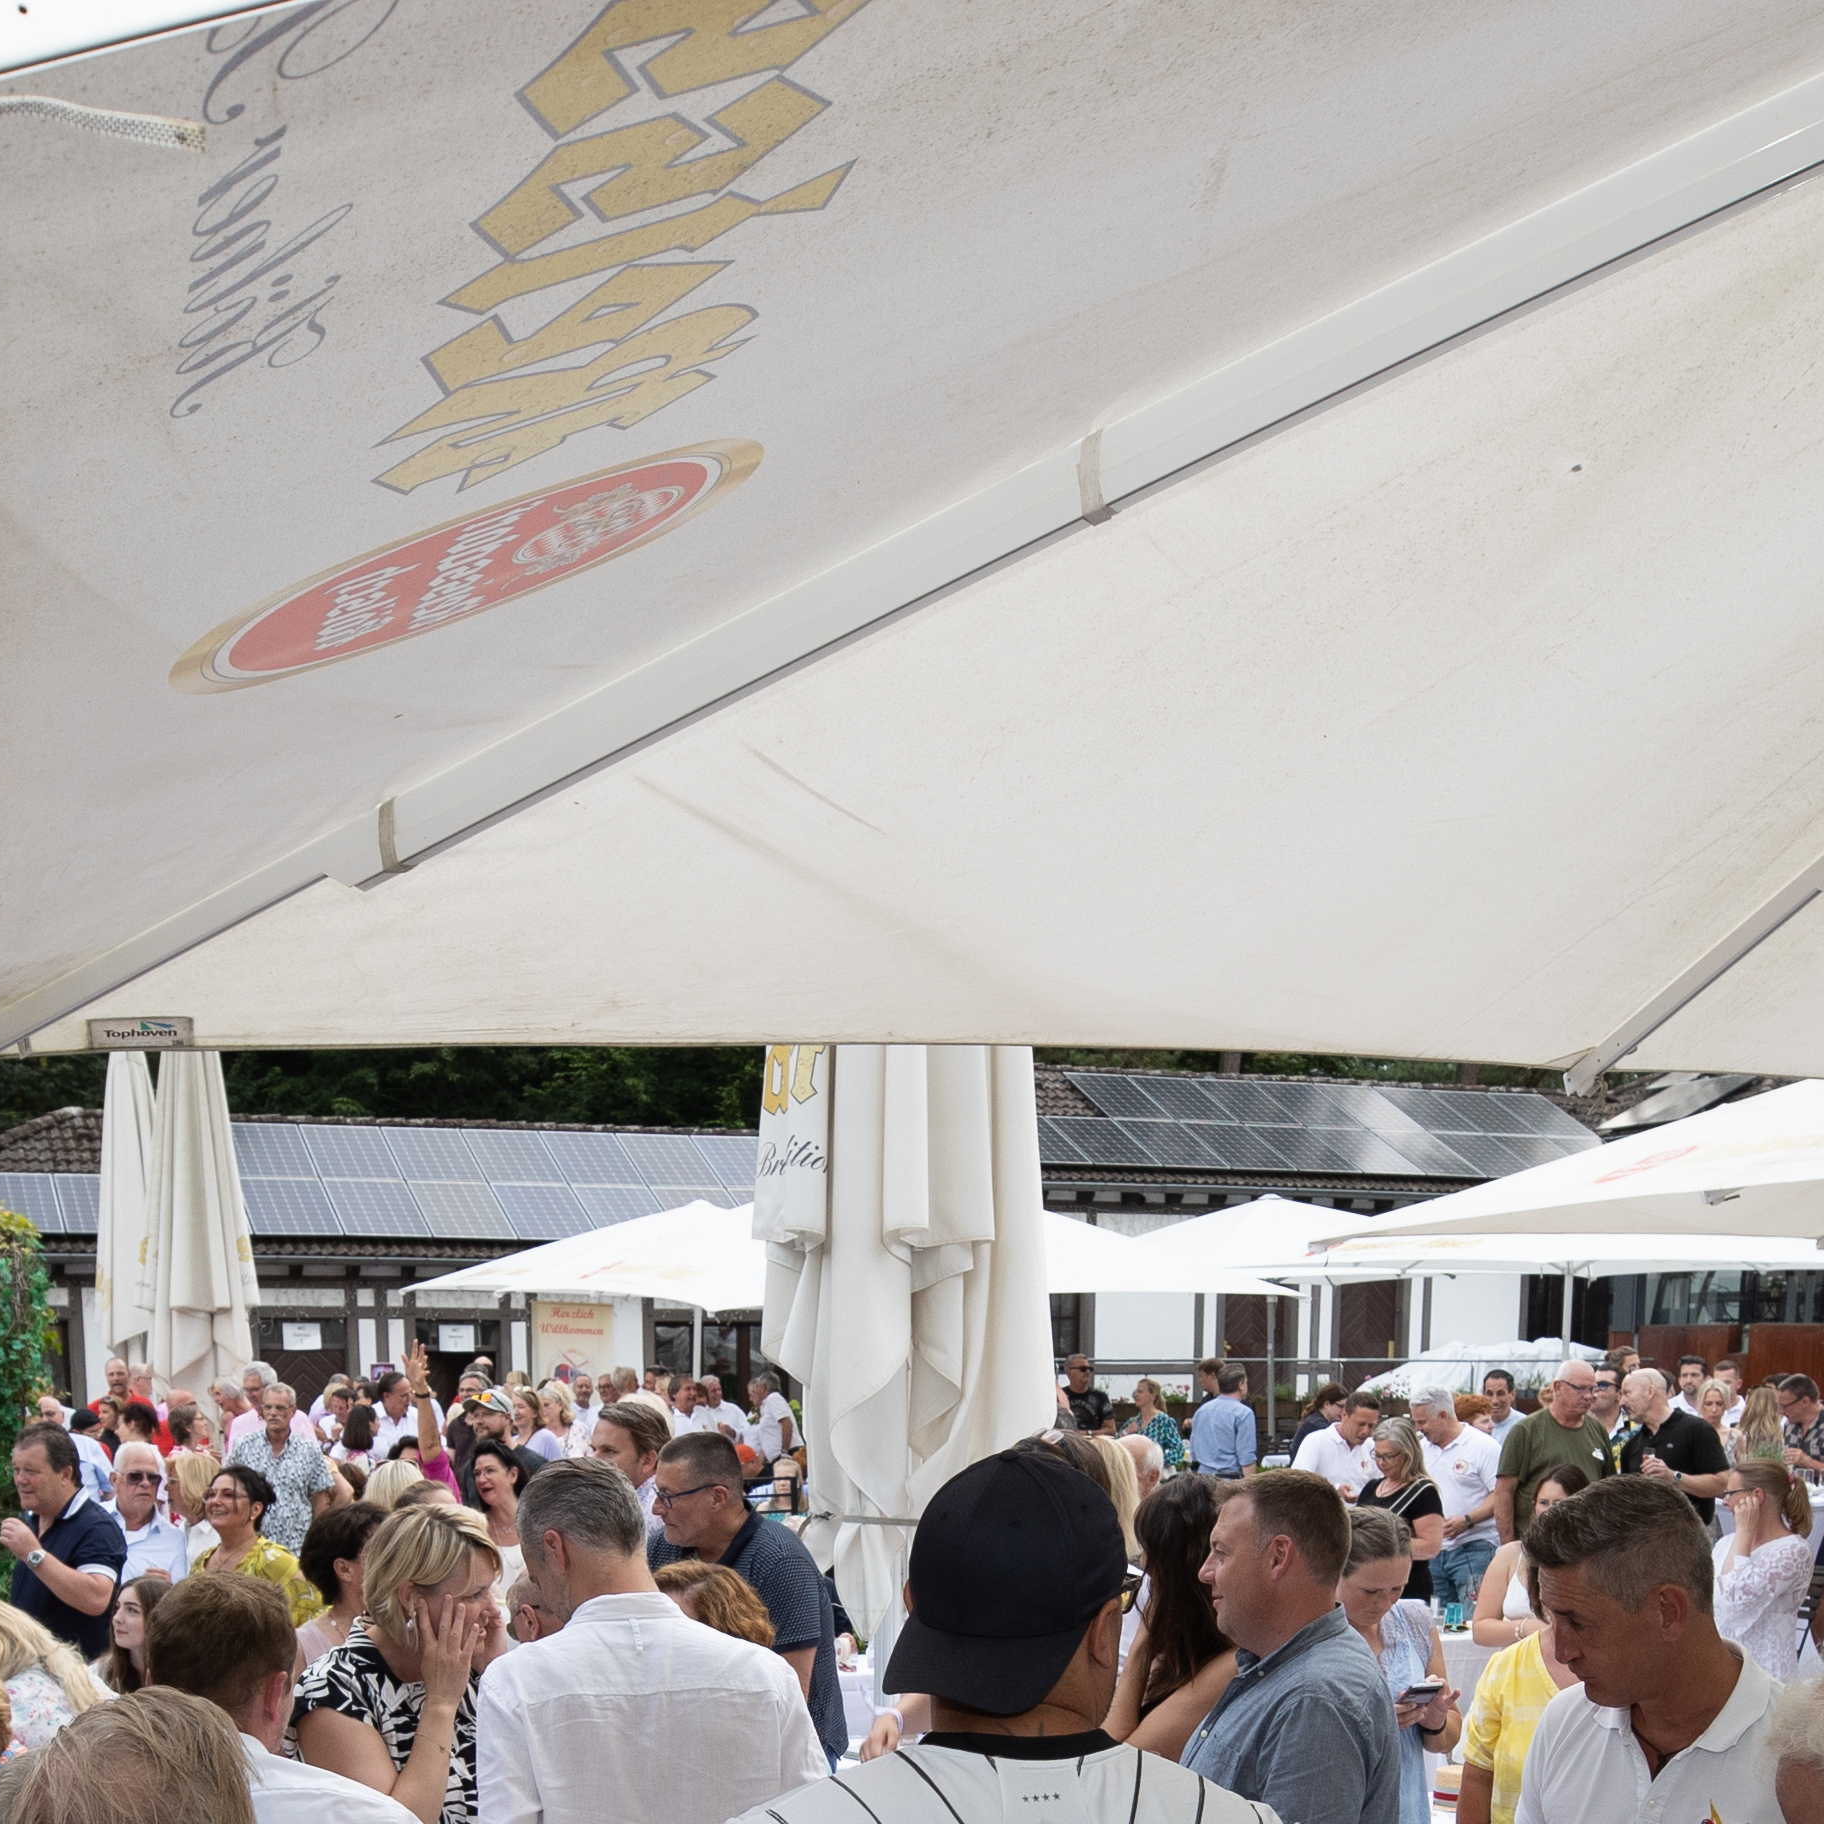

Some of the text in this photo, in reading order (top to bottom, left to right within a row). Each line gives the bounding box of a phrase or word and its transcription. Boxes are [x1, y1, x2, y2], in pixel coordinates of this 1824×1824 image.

[103, 1028, 178, 1040] Tophoven
[549, 1306, 595, 1319] Herzlich
[539, 1322, 604, 1335] Willkommen
